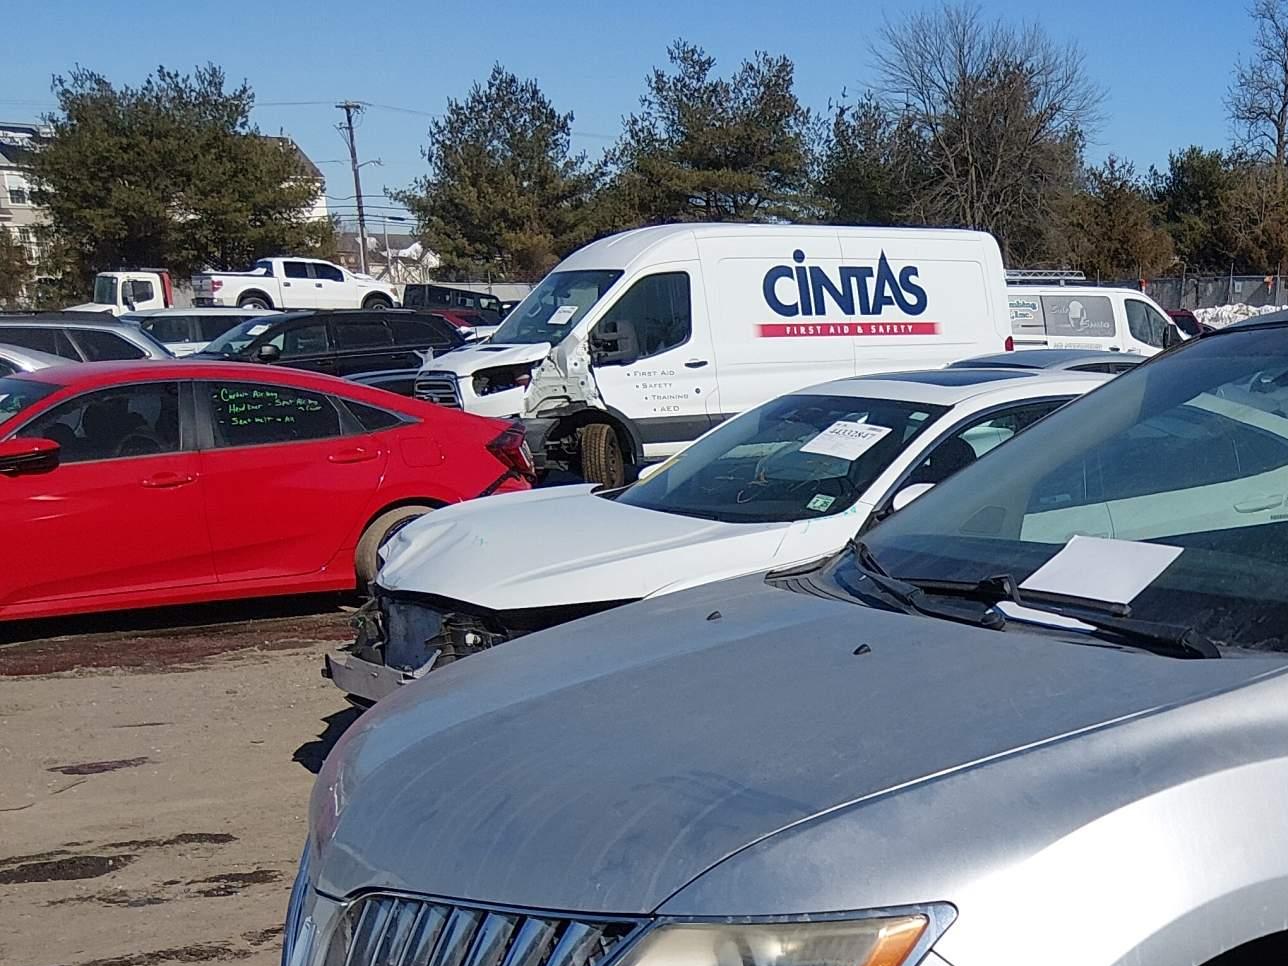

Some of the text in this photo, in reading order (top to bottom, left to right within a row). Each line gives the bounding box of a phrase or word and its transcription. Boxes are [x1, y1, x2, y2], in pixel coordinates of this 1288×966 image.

[786, 324, 913, 335] FIRST AID & SAFETY
